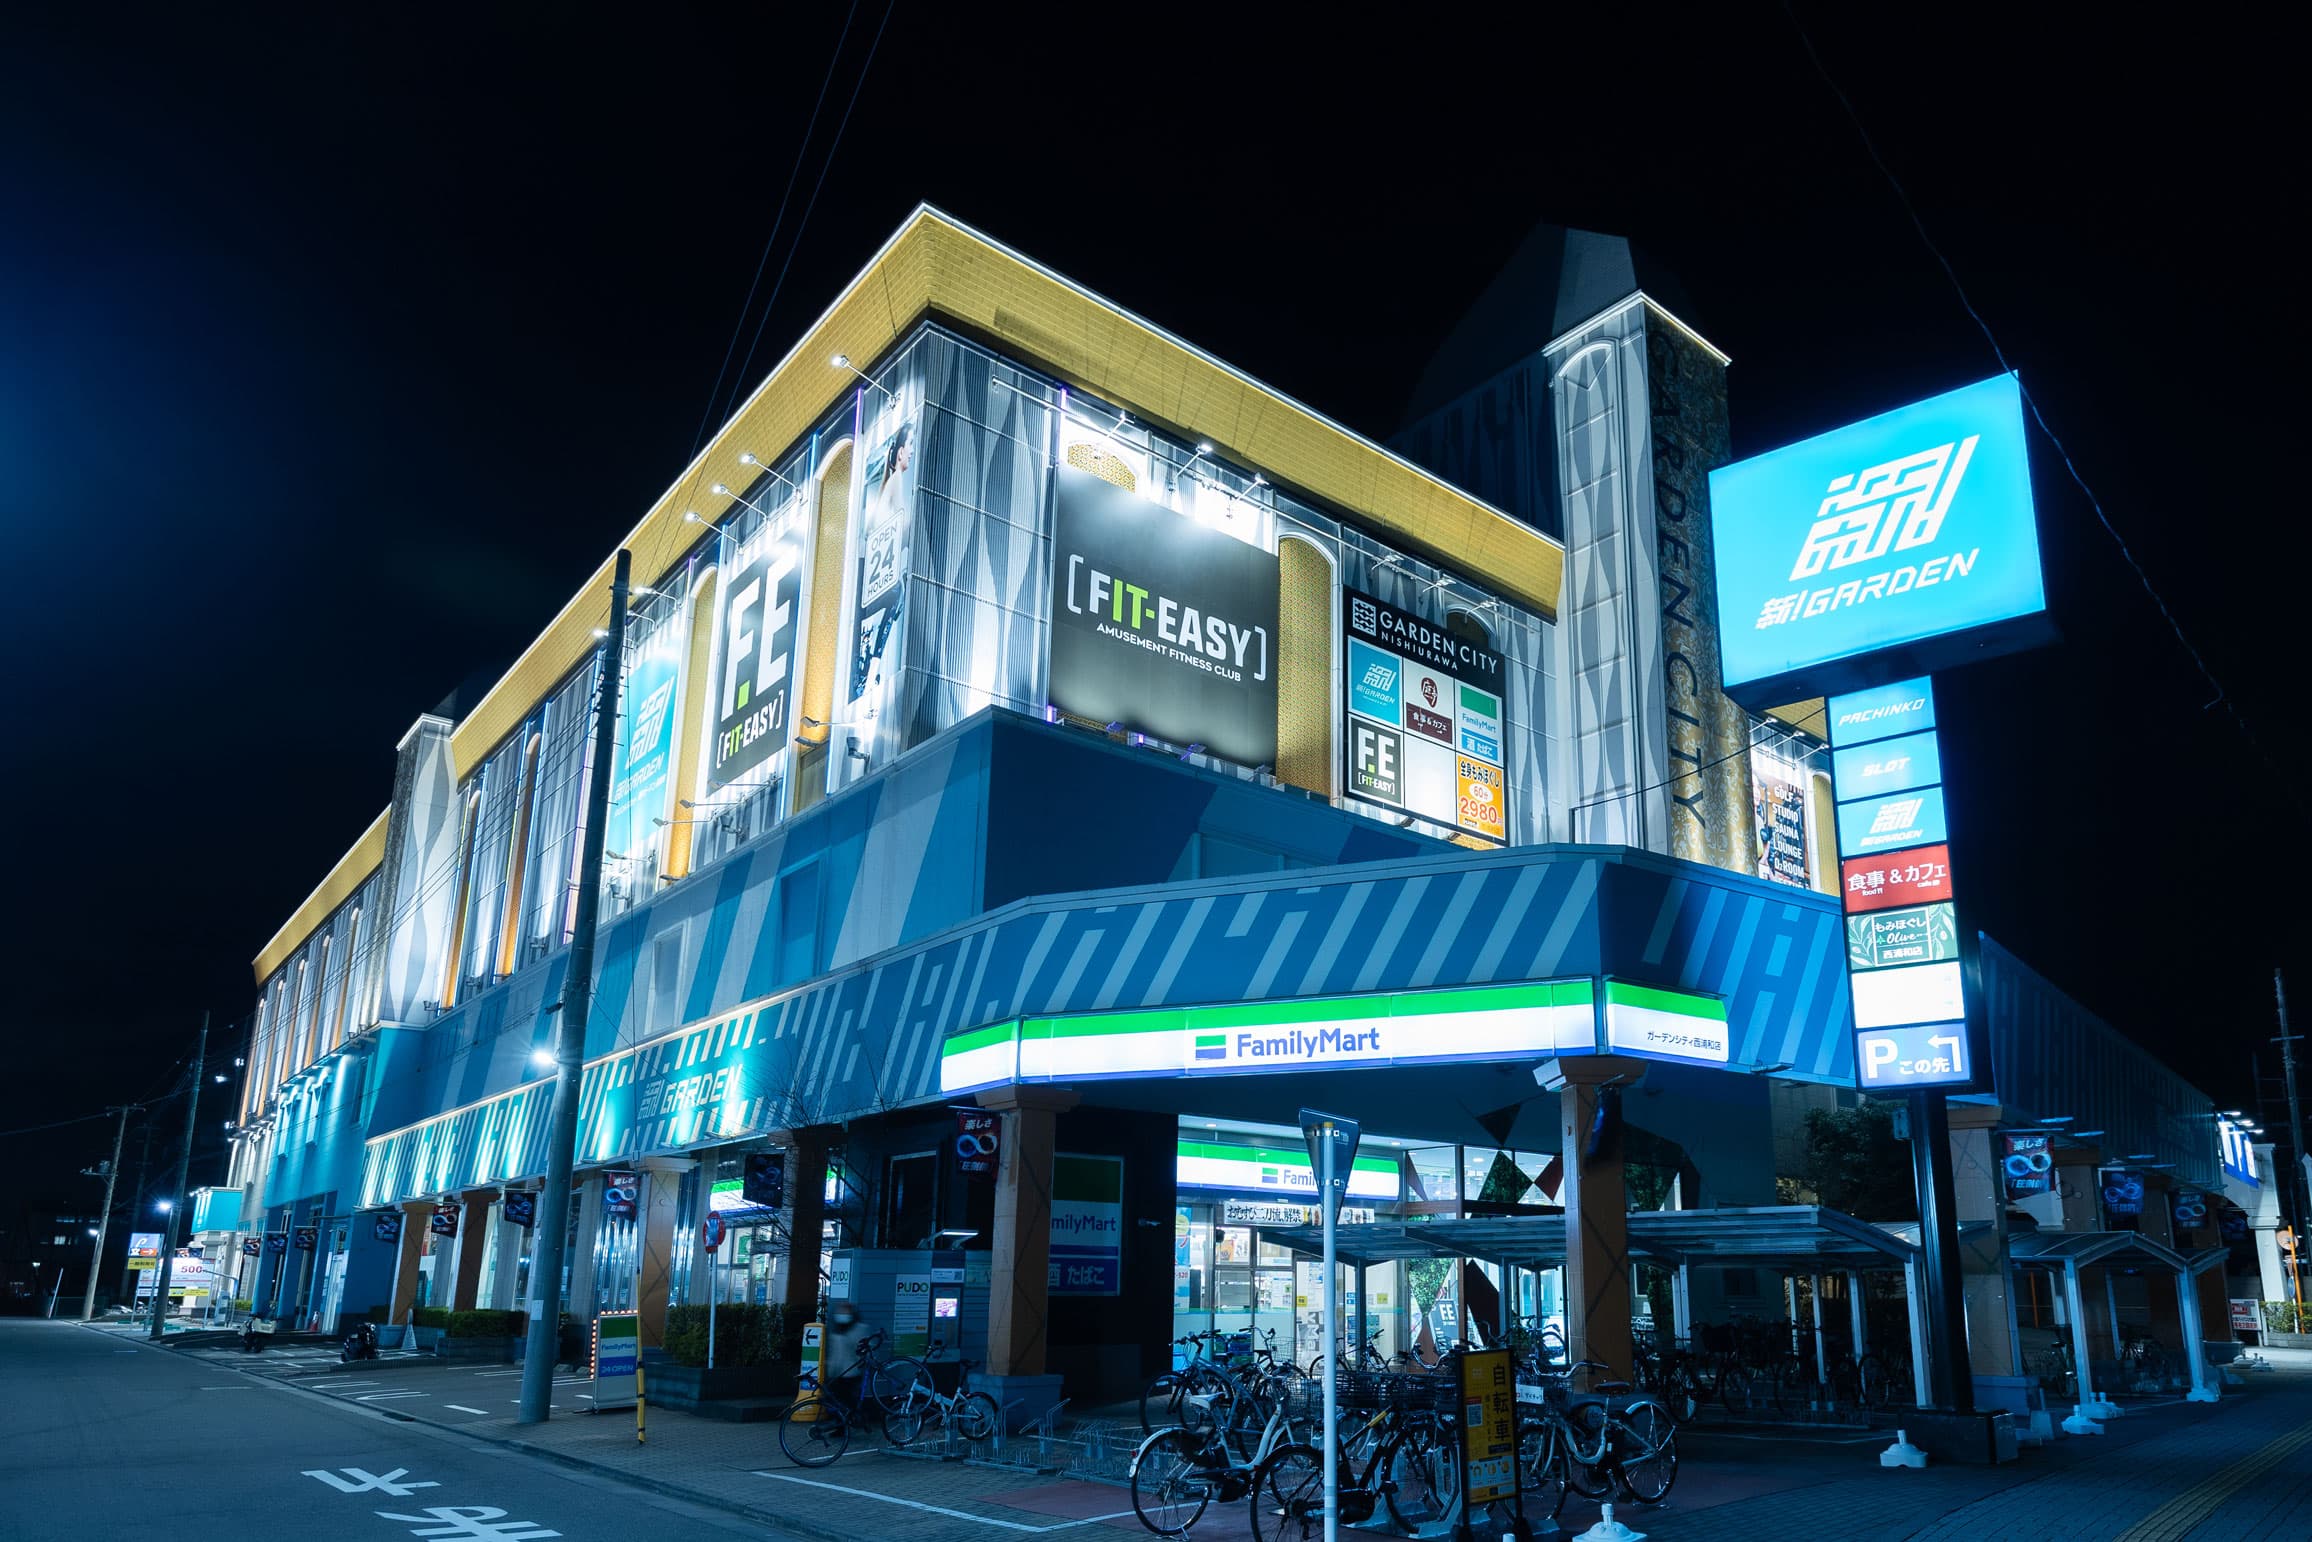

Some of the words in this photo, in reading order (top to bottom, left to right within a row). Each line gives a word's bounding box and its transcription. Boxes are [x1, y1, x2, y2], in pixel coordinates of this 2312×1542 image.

[871, 519, 898, 551] OPEN
[869, 538, 895, 585] 24
[867, 570, 895, 598] HOURS
[1096, 622, 1168, 656] AMUSEMENT
[1168, 648, 1213, 673] FITNESS
[1214, 665, 1242, 683] CLUB
[1379, 610, 1456, 657] GARDEN
[1459, 645, 1498, 674] CITY
[1381, 631, 1459, 671] NISHIURAWA
[1461, 712, 1497, 734] FamilyMart
[1837, 698, 1926, 727] PACHINKO
[1666, 651, 1706, 829] CITY
[1460, 760, 1500, 788] 全身もみほぐし
[1861, 757, 1912, 777] SLOT
[1774, 785, 1794, 802] GOLF
[1459, 796, 1497, 824] 2980
[1772, 803, 1799, 823] STUDIO
[1774, 823, 1800, 841] SAUNA
[1773, 839, 1803, 860] LOUNGE
[1875, 917, 1927, 933] もみほぐし
[1886, 931, 1917, 945] Olive
[1236, 1026, 1381, 1059] FamilyMart
[1647, 1031, 1722, 1052] ガーデンシティ西浦和店
[1864, 1037, 1899, 1080] P
[1899, 1056, 1951, 1075] この先
[660, 1063, 743, 1115] GARDEN
[1051, 1213, 1117, 1234] milyMart
[832, 1271, 849, 1282] PUDO
[897, 1281, 929, 1293] PUDO
[1067, 1265, 1105, 1286] たばこ
[1493, 1362, 1510, 1442] 自転車
